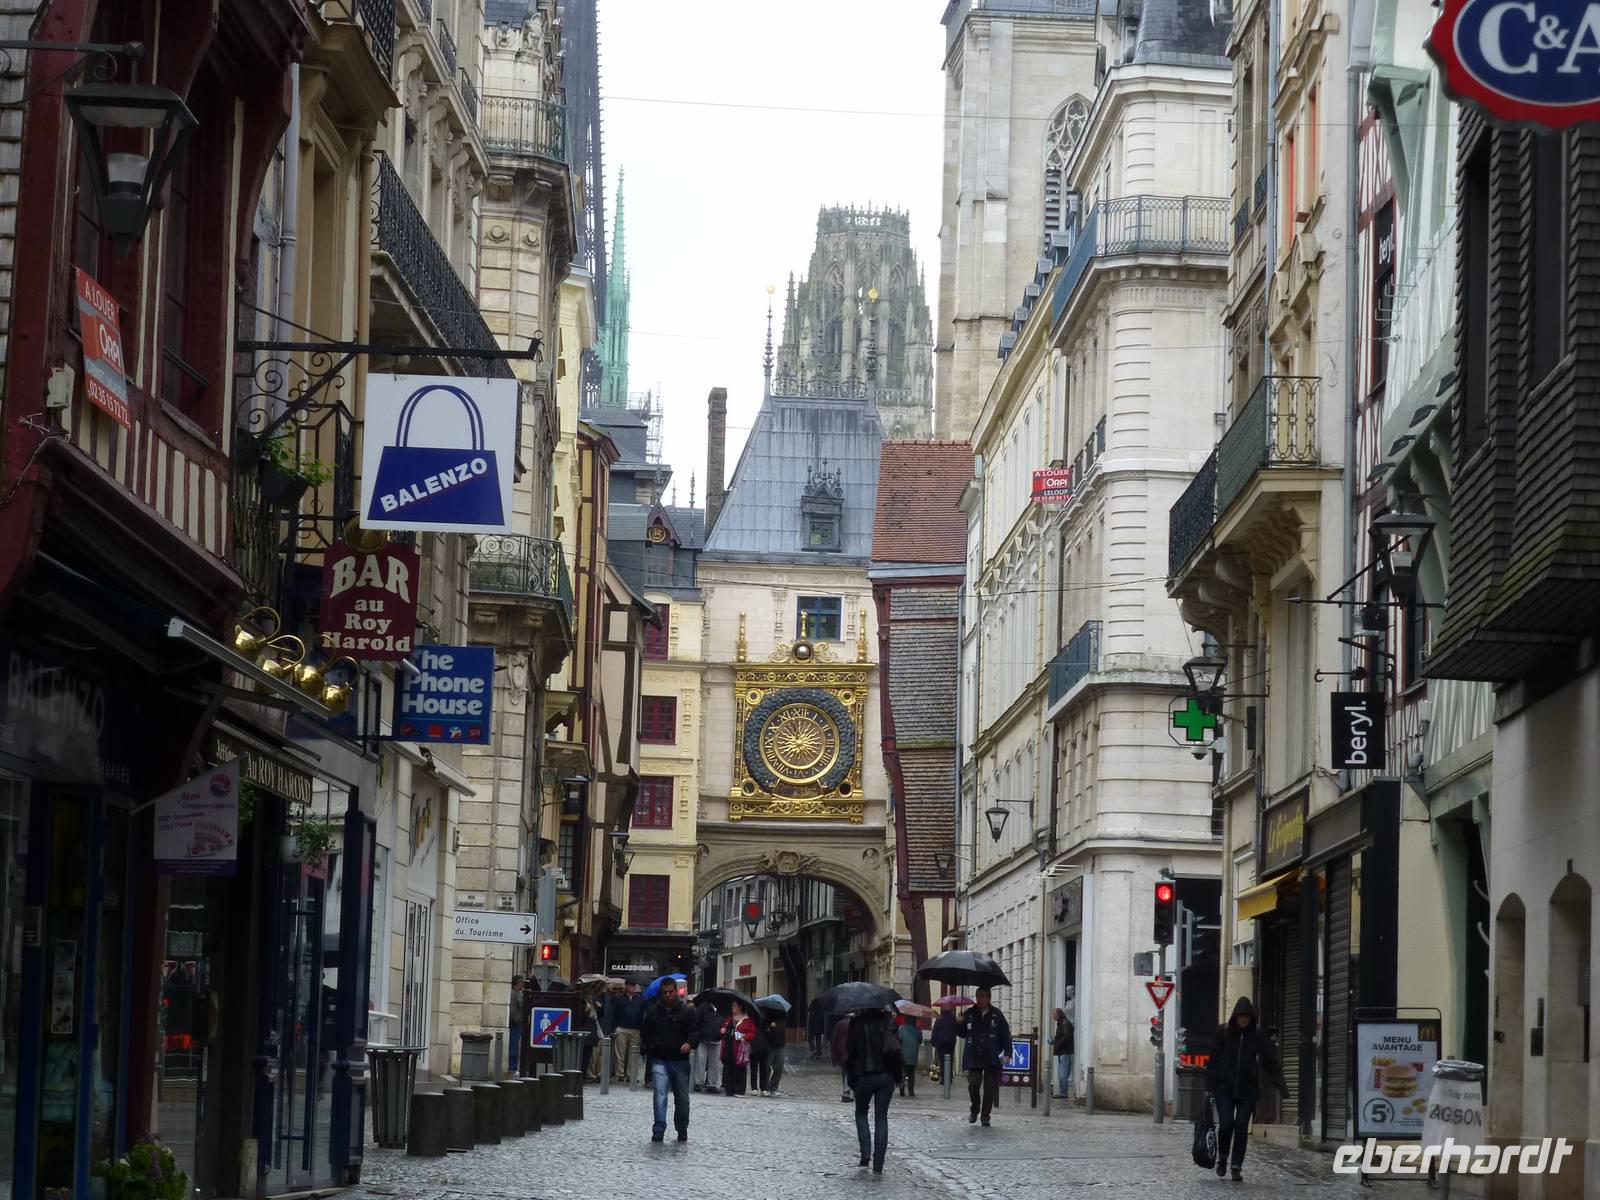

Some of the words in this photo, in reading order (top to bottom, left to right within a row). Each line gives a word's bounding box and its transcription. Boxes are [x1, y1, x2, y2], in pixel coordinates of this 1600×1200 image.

[1478, 2, 1600, 74] C&A
[85, 281, 92, 299] A
[92, 285, 116, 322] LOUER
[380, 457, 488, 513] BALENZO
[329, 554, 411, 604] BAR
[354, 599, 384, 613] au
[344, 613, 393, 635] Roy
[321, 631, 411, 652] Harold
[403, 671, 485, 694] Phone
[8, 650, 105, 743] BALENZO
[402, 693, 483, 716] House
[1344, 701, 1373, 764] beryl.
[258, 757, 276, 789] ROY
[277, 766, 311, 804] HAROLD
[455, 916, 480, 925] Office
[469, 928, 504, 938] Tourisme
[611, 964, 655, 972] CALZEDONIA
[1371, 1044, 1424, 1052] AVANTAGE
[1383, 1036, 1412, 1044] MENU
